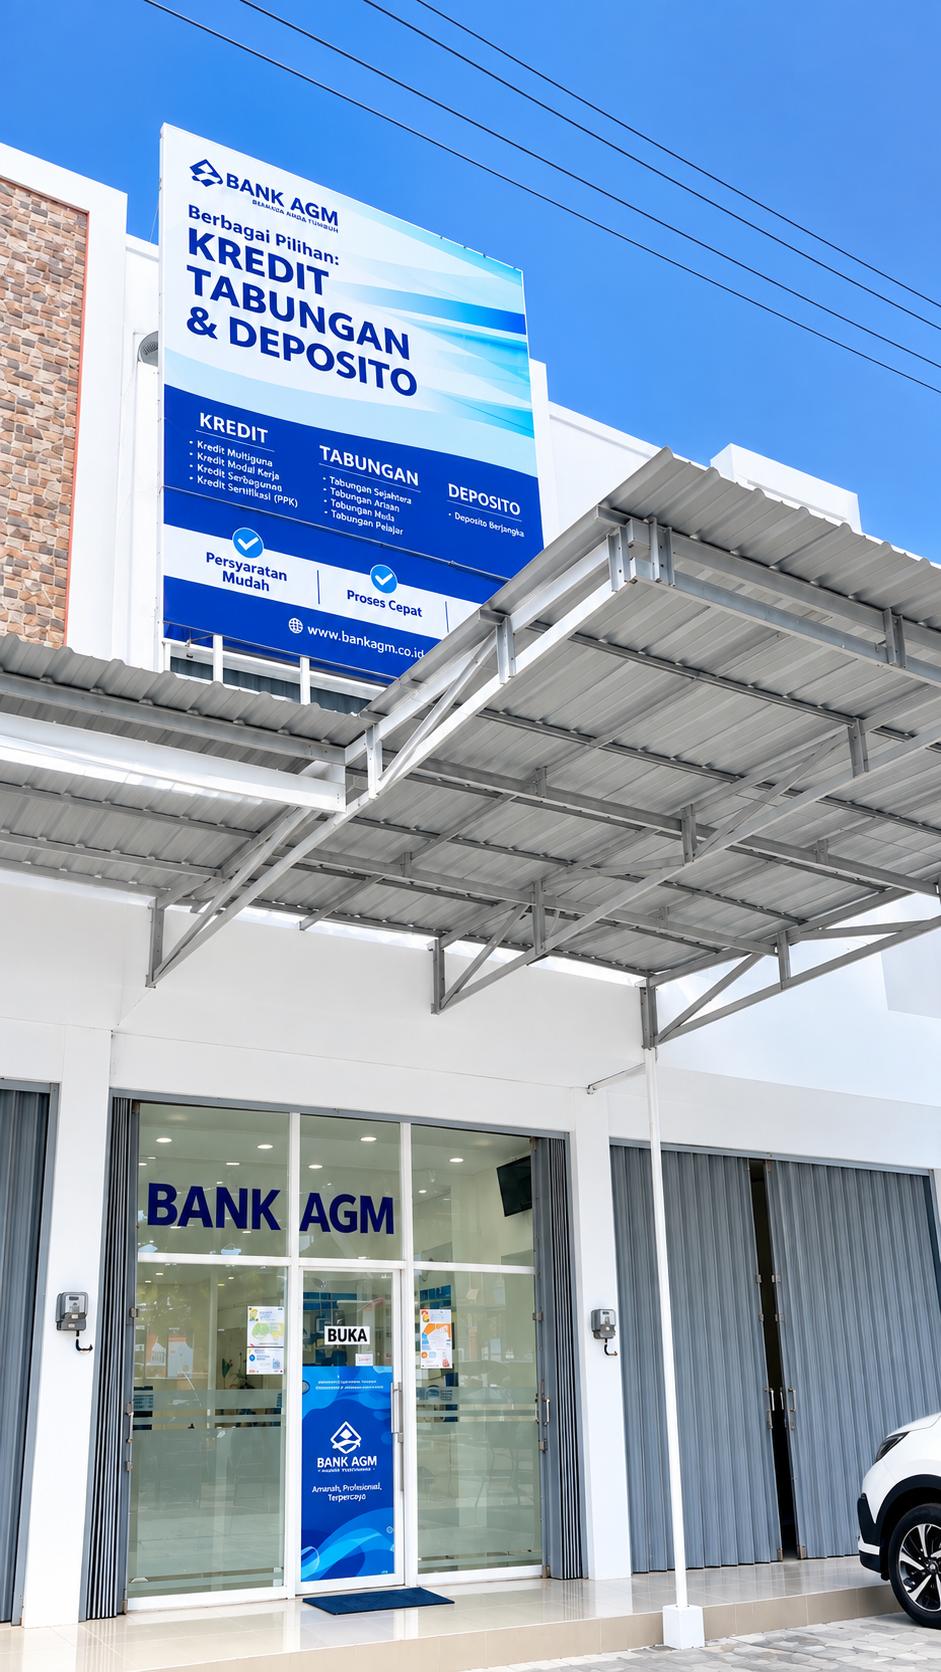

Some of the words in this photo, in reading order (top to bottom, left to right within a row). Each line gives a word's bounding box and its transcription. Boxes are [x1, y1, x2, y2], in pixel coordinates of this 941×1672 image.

[227, 172, 285, 208] BANK
[290, 197, 339, 227] AGM
[188, 204, 270, 243] Berbagai
[276, 233, 339, 265] Pilihan:
[188, 227, 329, 296] KREDIT
[186, 264, 410, 361] TABUNGAN
[186, 306, 218, 340] &
[229, 316, 418, 397] DEPOSITO
[200, 412, 269, 443] KREDIT
[197, 440, 225, 455] Kredit
[227, 448, 273, 467] Multiguna
[197, 452, 225, 467] Kredit
[257, 468, 280, 482] Kerja
[319, 444, 419, 487] TABUNGAN
[197, 464, 225, 479] Kredit
[329, 475, 372, 494] Tabungan
[197, 475, 226, 490] Kredit
[273, 494, 298, 508] (PPK)
[330, 487, 372, 505] Tabungan
[448, 482, 521, 516] DEPOSITO
[330, 498, 372, 517] Tabungan
[331, 509, 374, 527] Tabungan
[205, 551, 288, 582] Persyaratan
[222, 570, 270, 592] Mudah
[346, 589, 386, 609] Proses
[388, 600, 423, 618] Cepat
[307, 626, 425, 659] www.bankagm.co.id
[147, 1182, 282, 1231] BANK
[299, 1192, 395, 1235] AGM
[327, 1328, 368, 1343] BUKA
[317, 1456, 349, 1468] BANK
[351, 1455, 377, 1467] AGM
